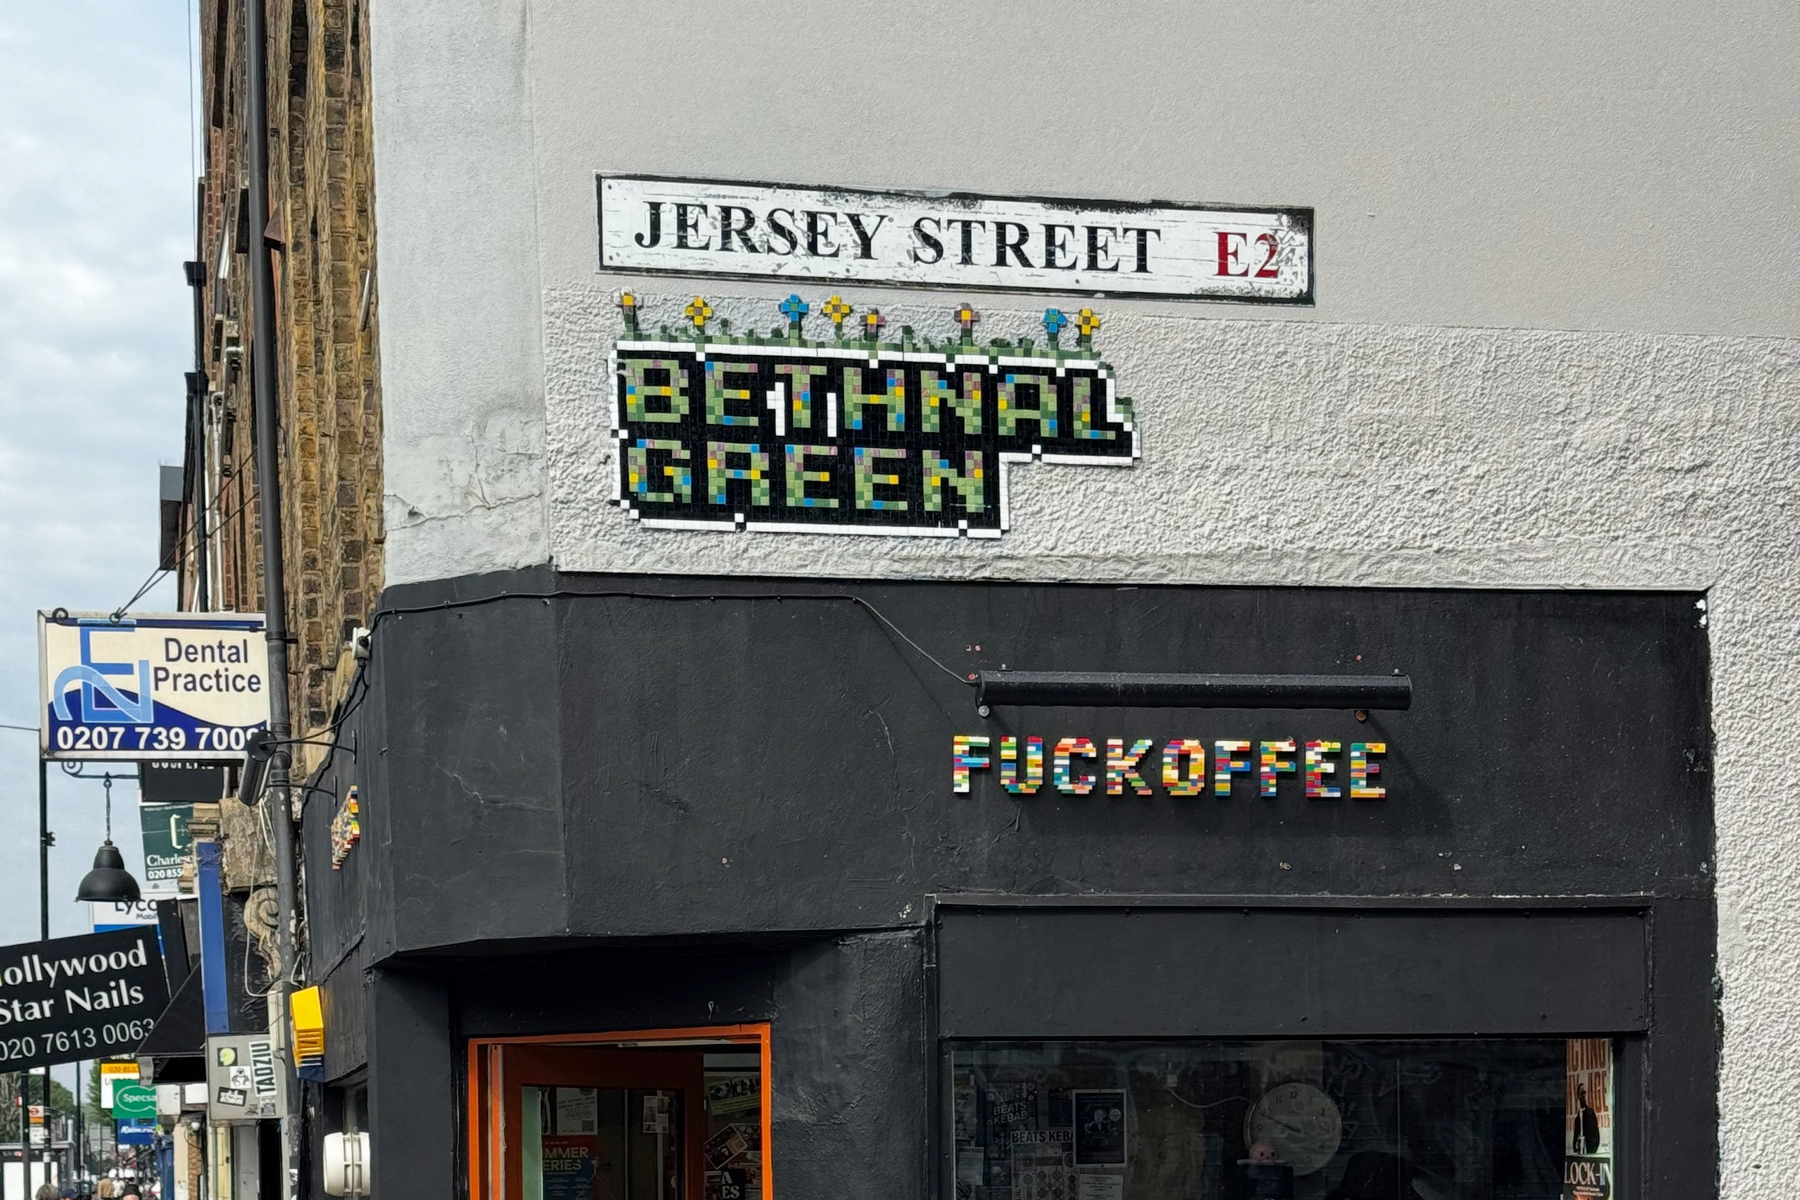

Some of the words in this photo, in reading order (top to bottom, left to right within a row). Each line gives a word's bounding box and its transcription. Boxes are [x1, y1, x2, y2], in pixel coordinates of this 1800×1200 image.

[633, 198, 886, 262] JERSEY
[912, 216, 1163, 274] STREET
[1215, 230, 1281, 279] E2
[625, 358, 1117, 441] BETHNAL
[627, 439, 986, 513] GREEN
[164, 636, 249, 664] Dental
[153, 666, 262, 693] Practice
[57, 726, 125, 750] 0207
[135, 726, 186, 750] 739
[953, 734, 1386, 799] FUCKOFFEE
[148, 869, 165, 879] 020
[0, 938, 148, 989] ollywood
[0, 998, 54, 1026] Star
[64, 979, 145, 1015] Nails
[0, 1036, 36, 1062] 020
[41, 1027, 97, 1054] 7613
[102, 1018, 154, 1045] 0063
[251, 1042, 276, 1095] TADZIU
[993, 1111, 1028, 1126] KEBAB
[994, 1101, 1027, 1116] BEATS
[1012, 1131, 1046, 1143] BEATS
